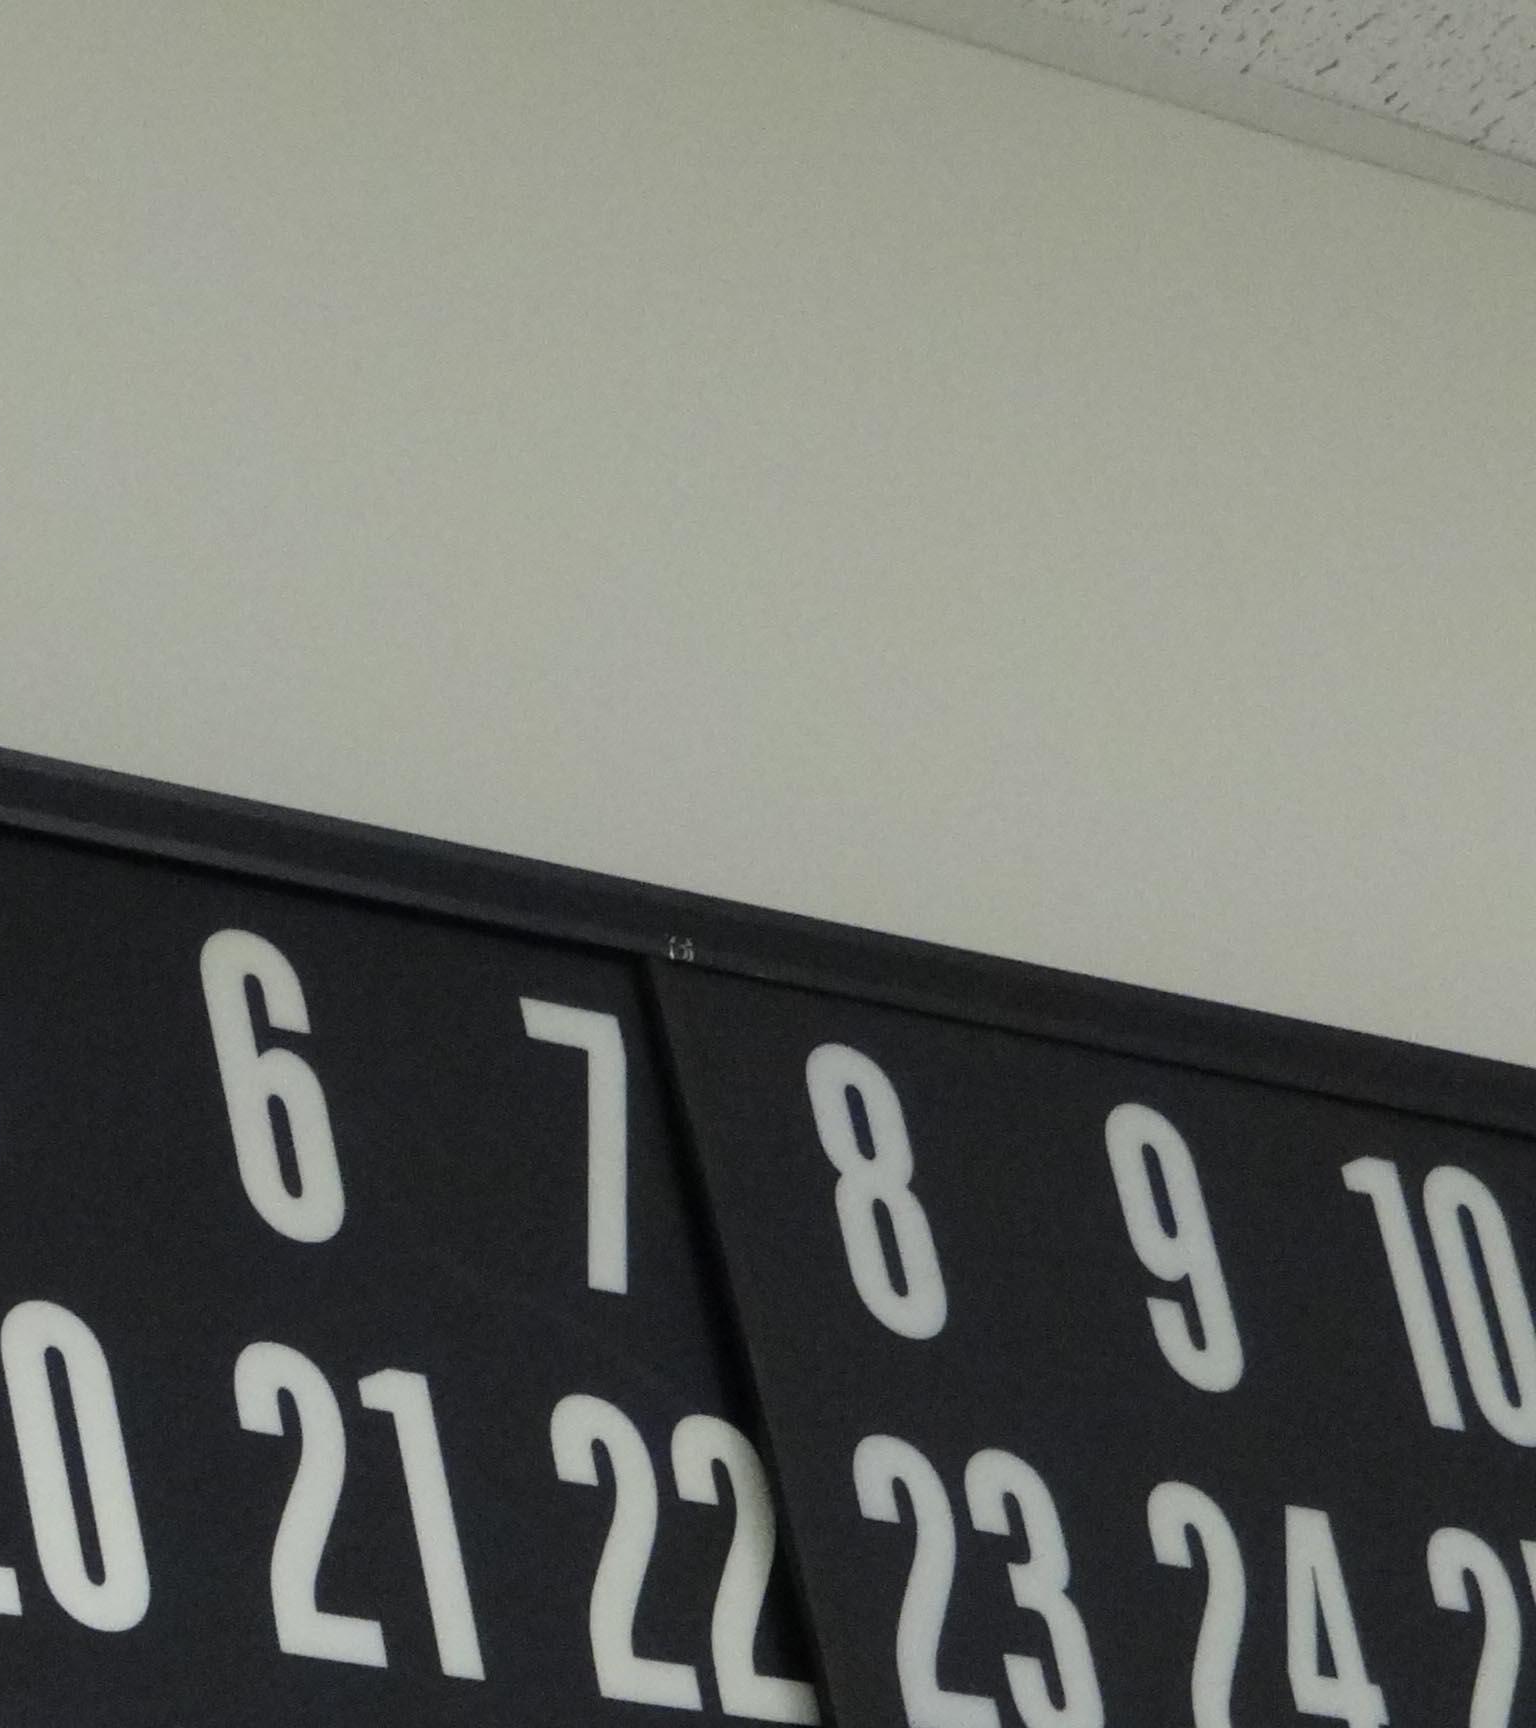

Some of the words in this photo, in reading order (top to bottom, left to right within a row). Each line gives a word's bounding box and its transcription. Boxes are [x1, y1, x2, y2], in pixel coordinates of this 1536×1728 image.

[200, 929, 345, 1242] 6
[520, 998, 627, 1294] 7
[806, 1044, 947, 1339] 8
[1105, 1104, 1244, 1392] 9
[1342, 1157, 1536, 1447] 10
[234, 1342, 485, 1680] 21
[550, 1394, 812, 1723] 22
